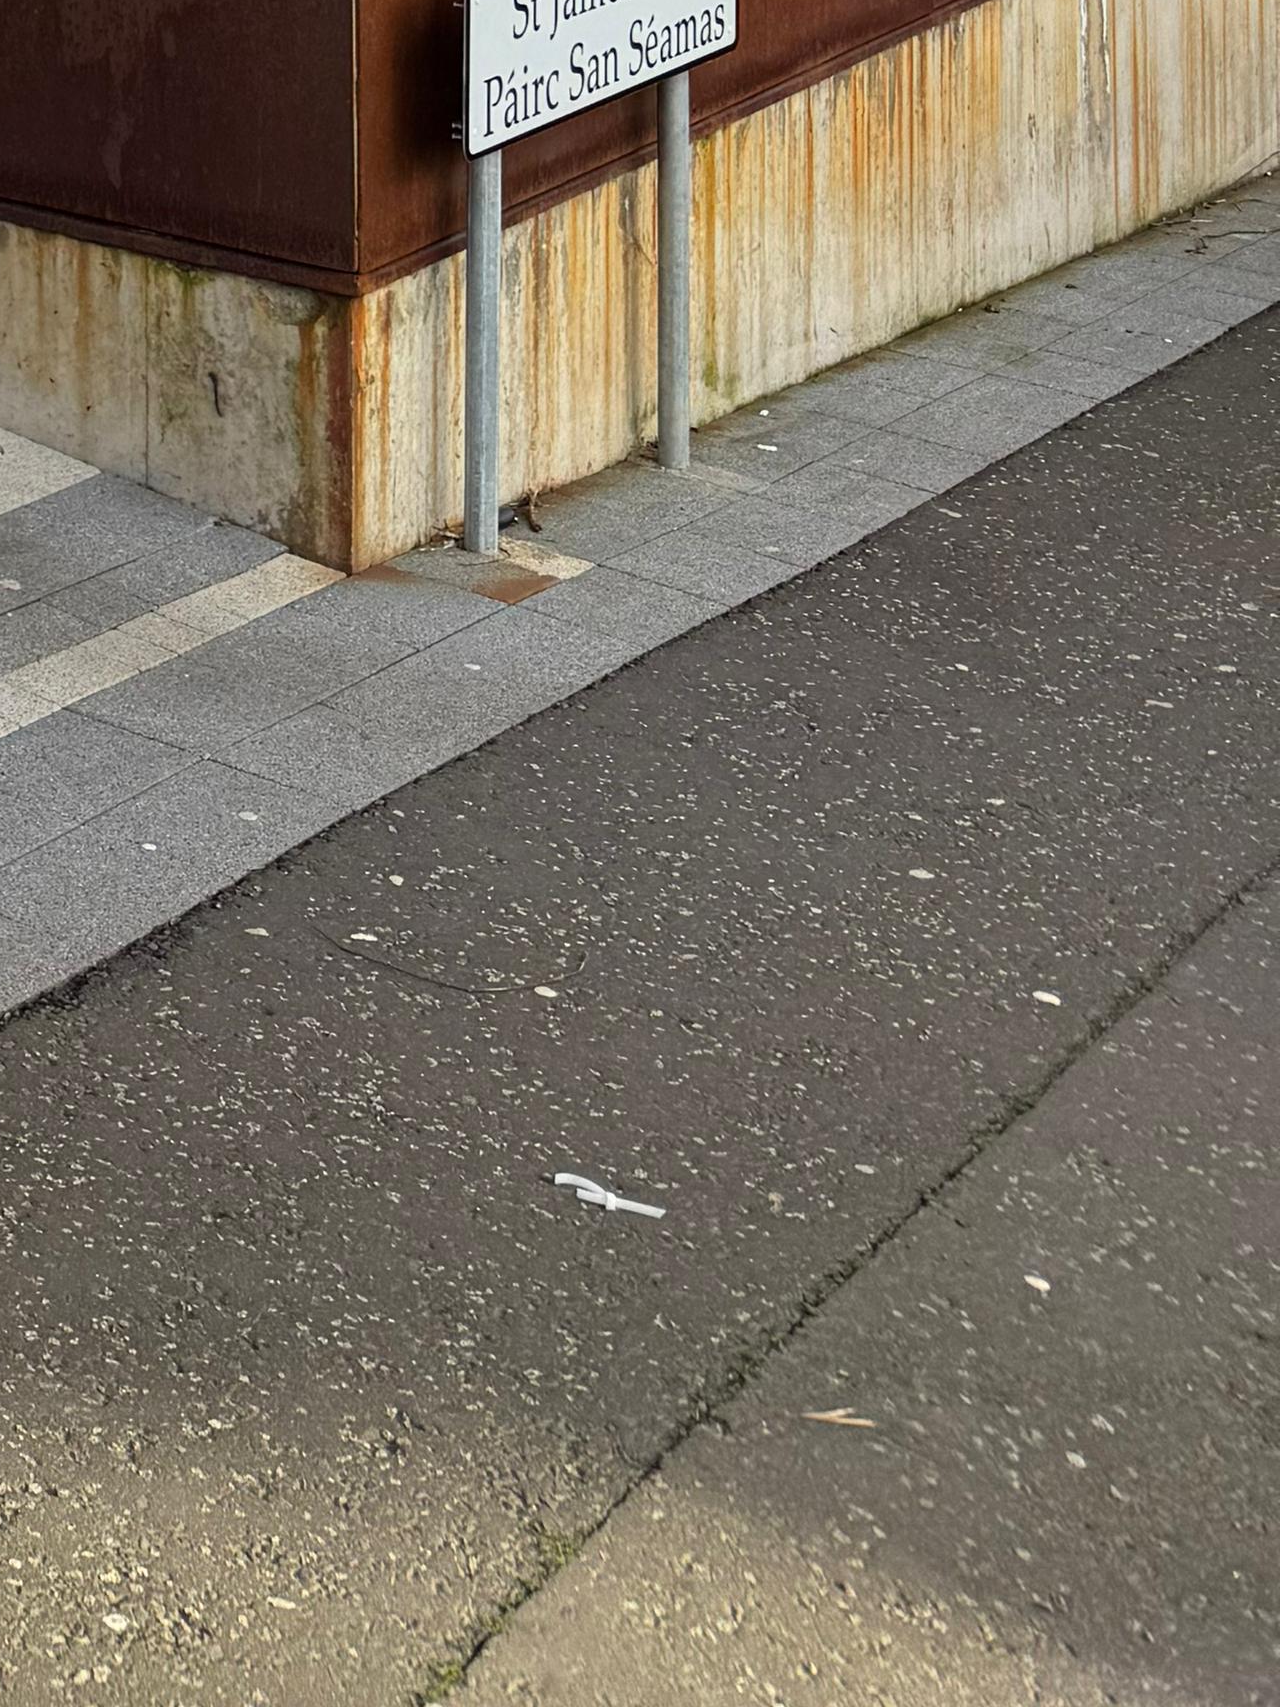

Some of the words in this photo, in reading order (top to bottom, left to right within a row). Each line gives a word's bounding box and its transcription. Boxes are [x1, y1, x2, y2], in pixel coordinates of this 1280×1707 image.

[483, 65, 560, 138] Páirc
[568, 42, 621, 101] San
[628, 2, 726, 76] Séamas
